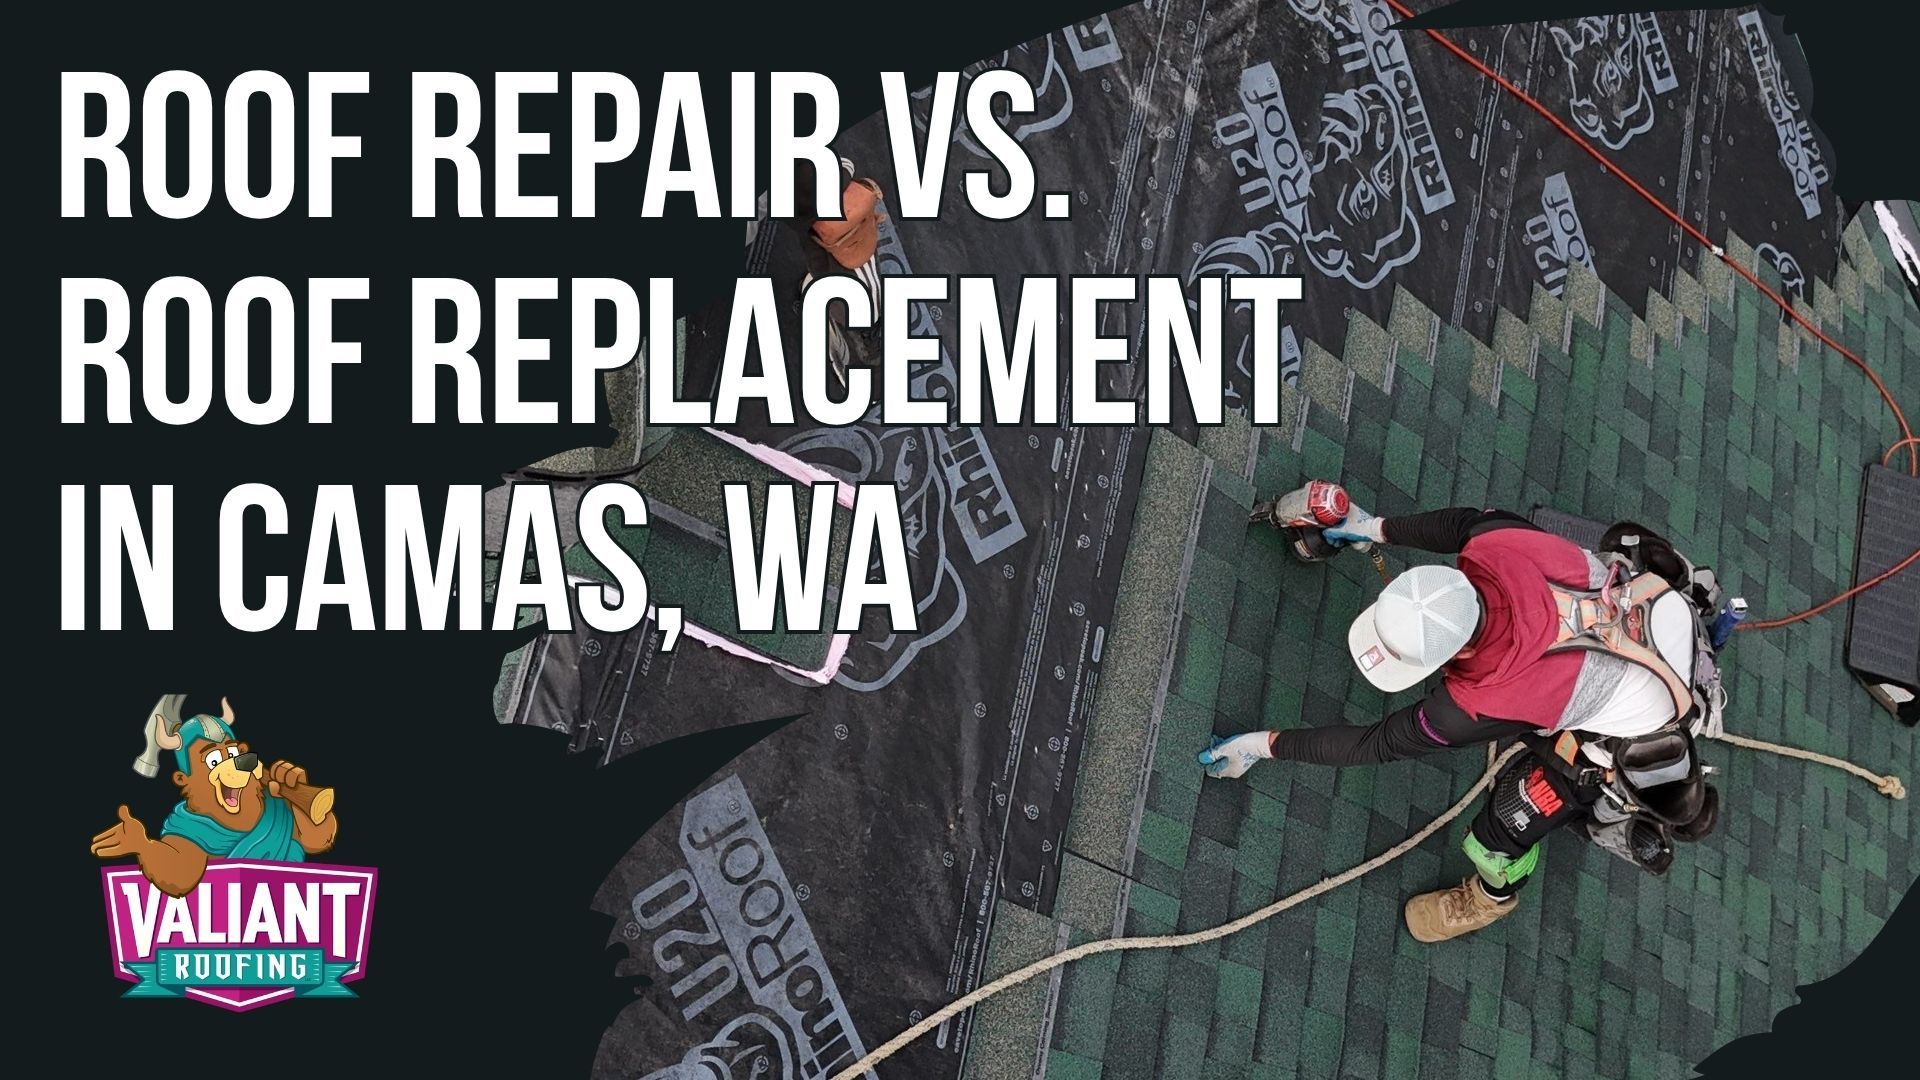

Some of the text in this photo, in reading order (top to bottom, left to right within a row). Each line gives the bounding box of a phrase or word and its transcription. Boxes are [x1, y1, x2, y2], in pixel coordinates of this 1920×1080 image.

[1216, 112, 1275, 213] U20
[1745, 22, 1817, 201] RhinoRoof
[1797, 119, 1829, 187] U20
[632, 868, 739, 1022] U20
